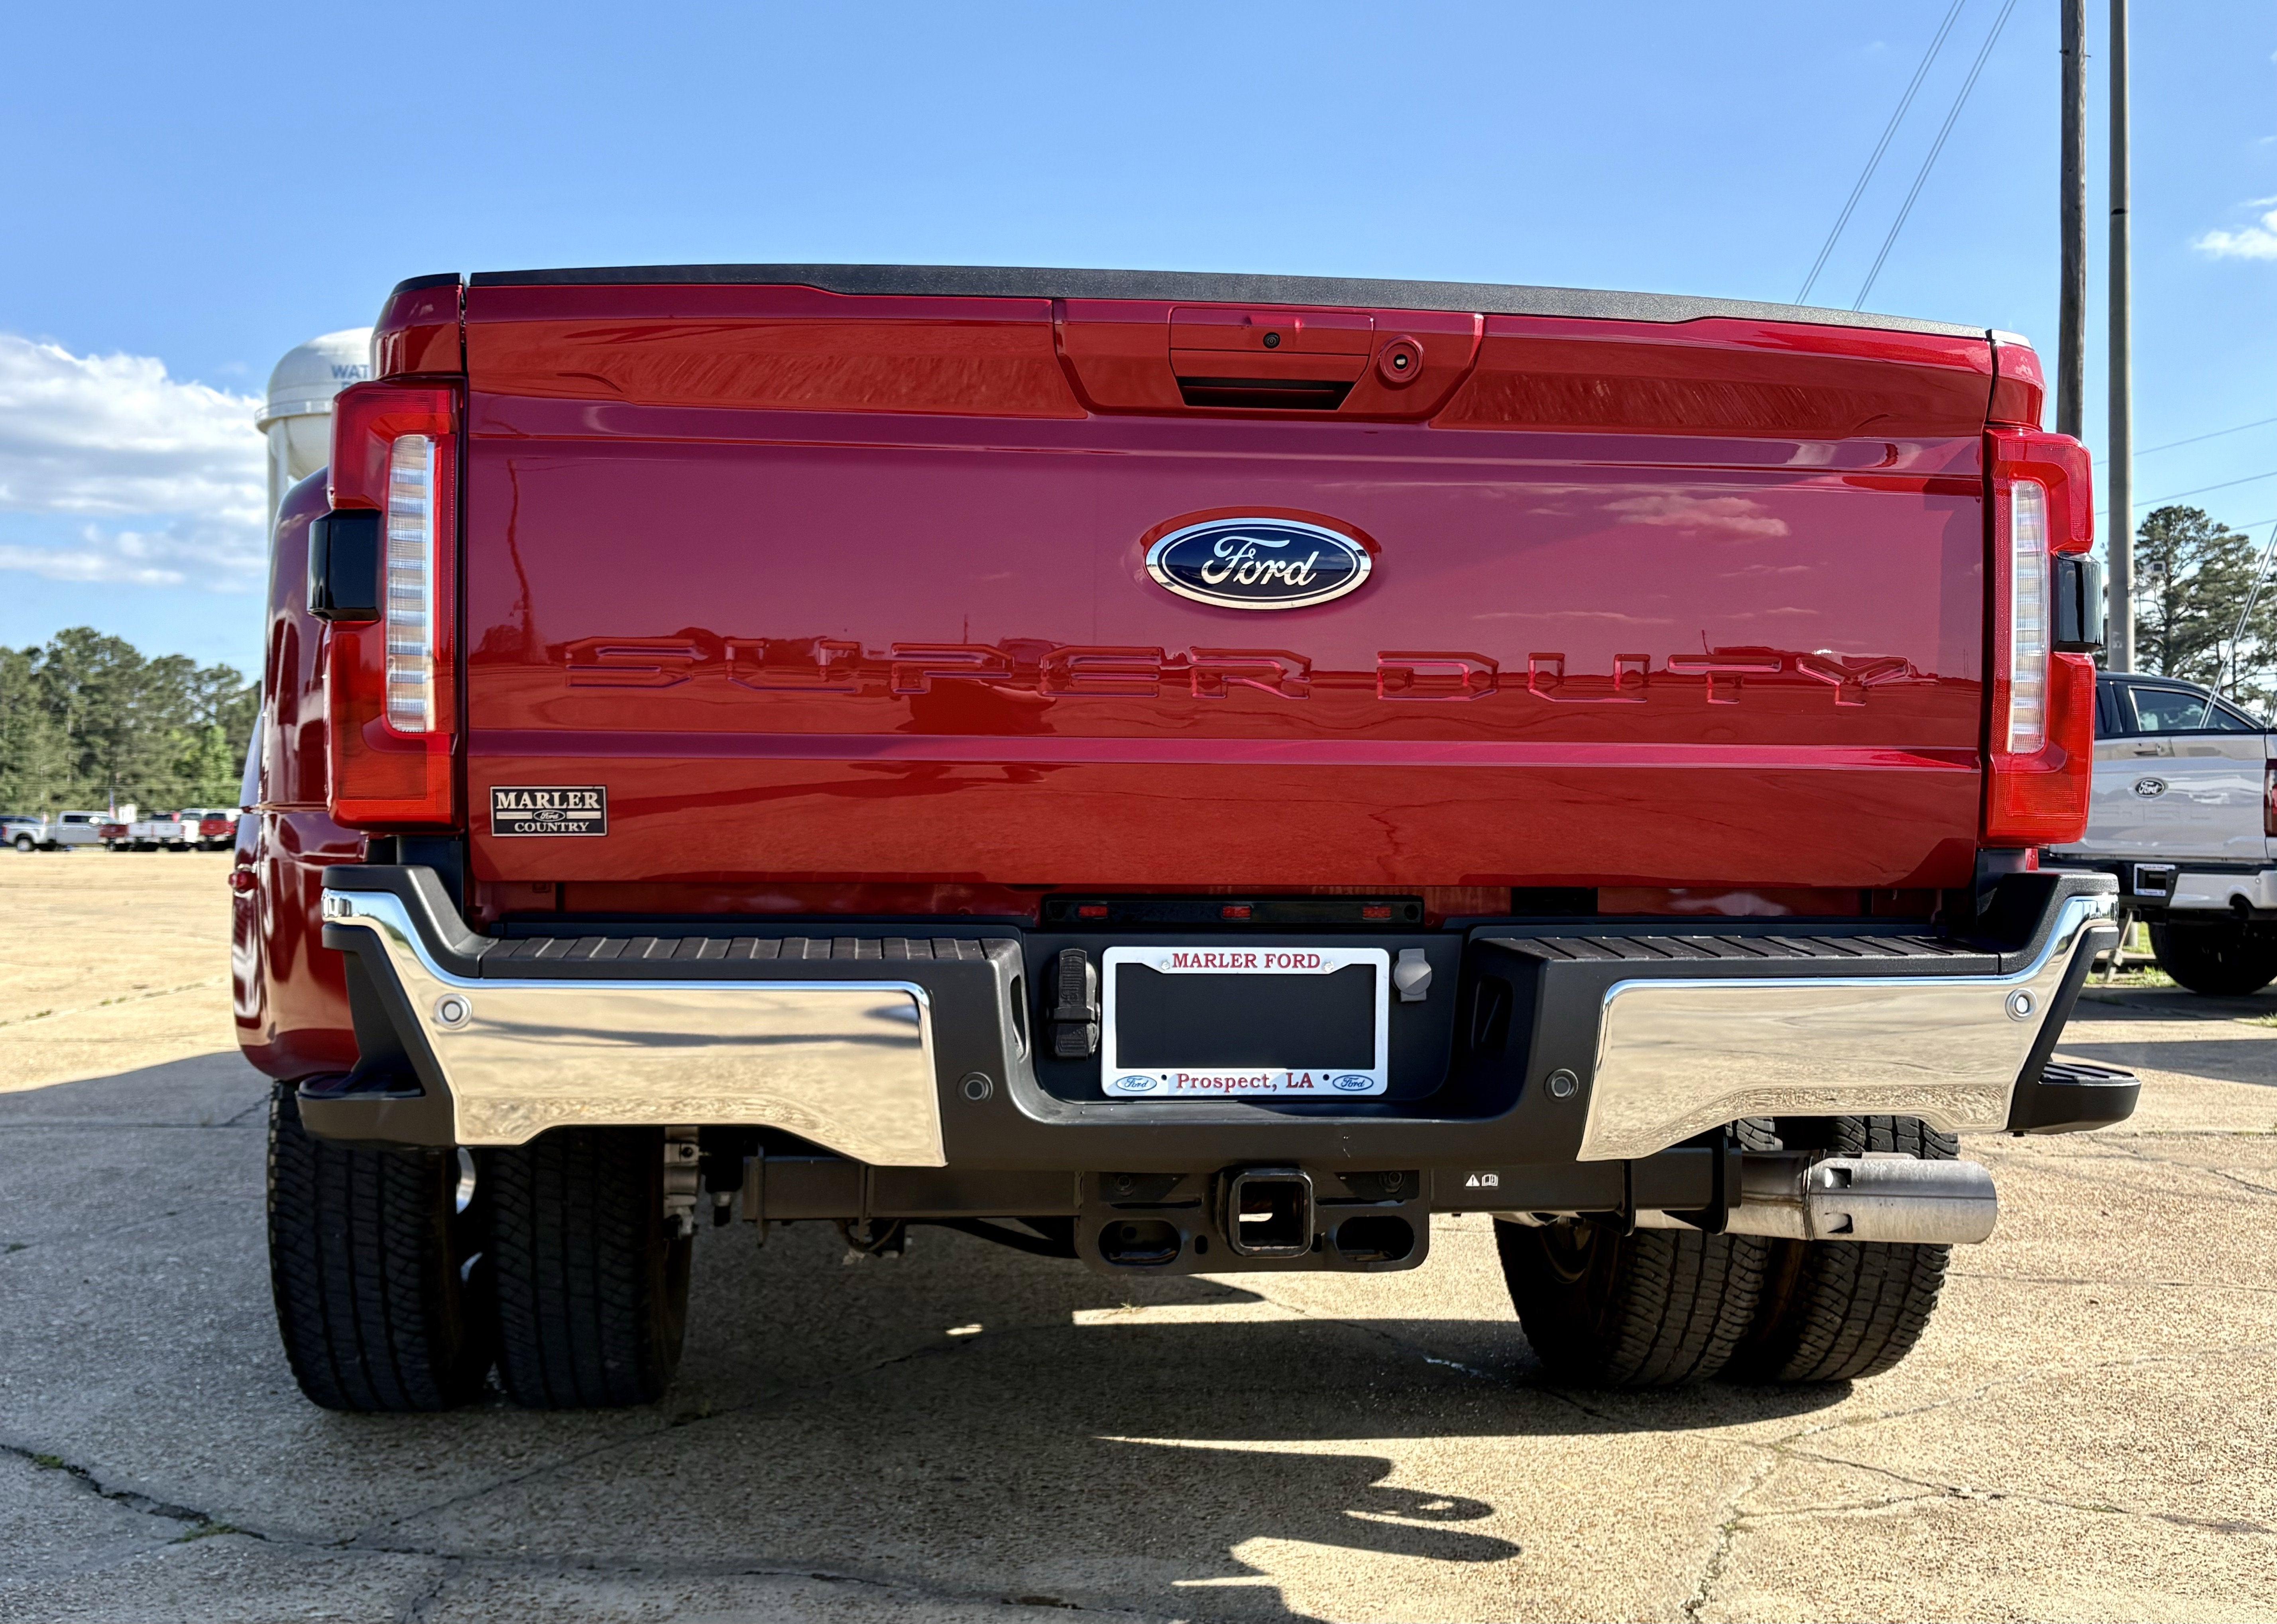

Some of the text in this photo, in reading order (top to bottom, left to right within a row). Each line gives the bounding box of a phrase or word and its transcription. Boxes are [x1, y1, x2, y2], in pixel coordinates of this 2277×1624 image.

[1201, 536, 1319, 586] Ford
[564, 637, 1911, 706] SUPER DUTY
[2138, 780, 2158, 794] Ford
[496, 791, 601, 809] MARLER
[514, 822, 589, 832] COUNTRY
[1172, 953, 1321, 969] MARLER FORD
[1125, 1077, 1148, 1088] Ford
[1176, 1072, 1314, 1093] Prospect, LA
[1341, 1077, 1365, 1088] Ford
